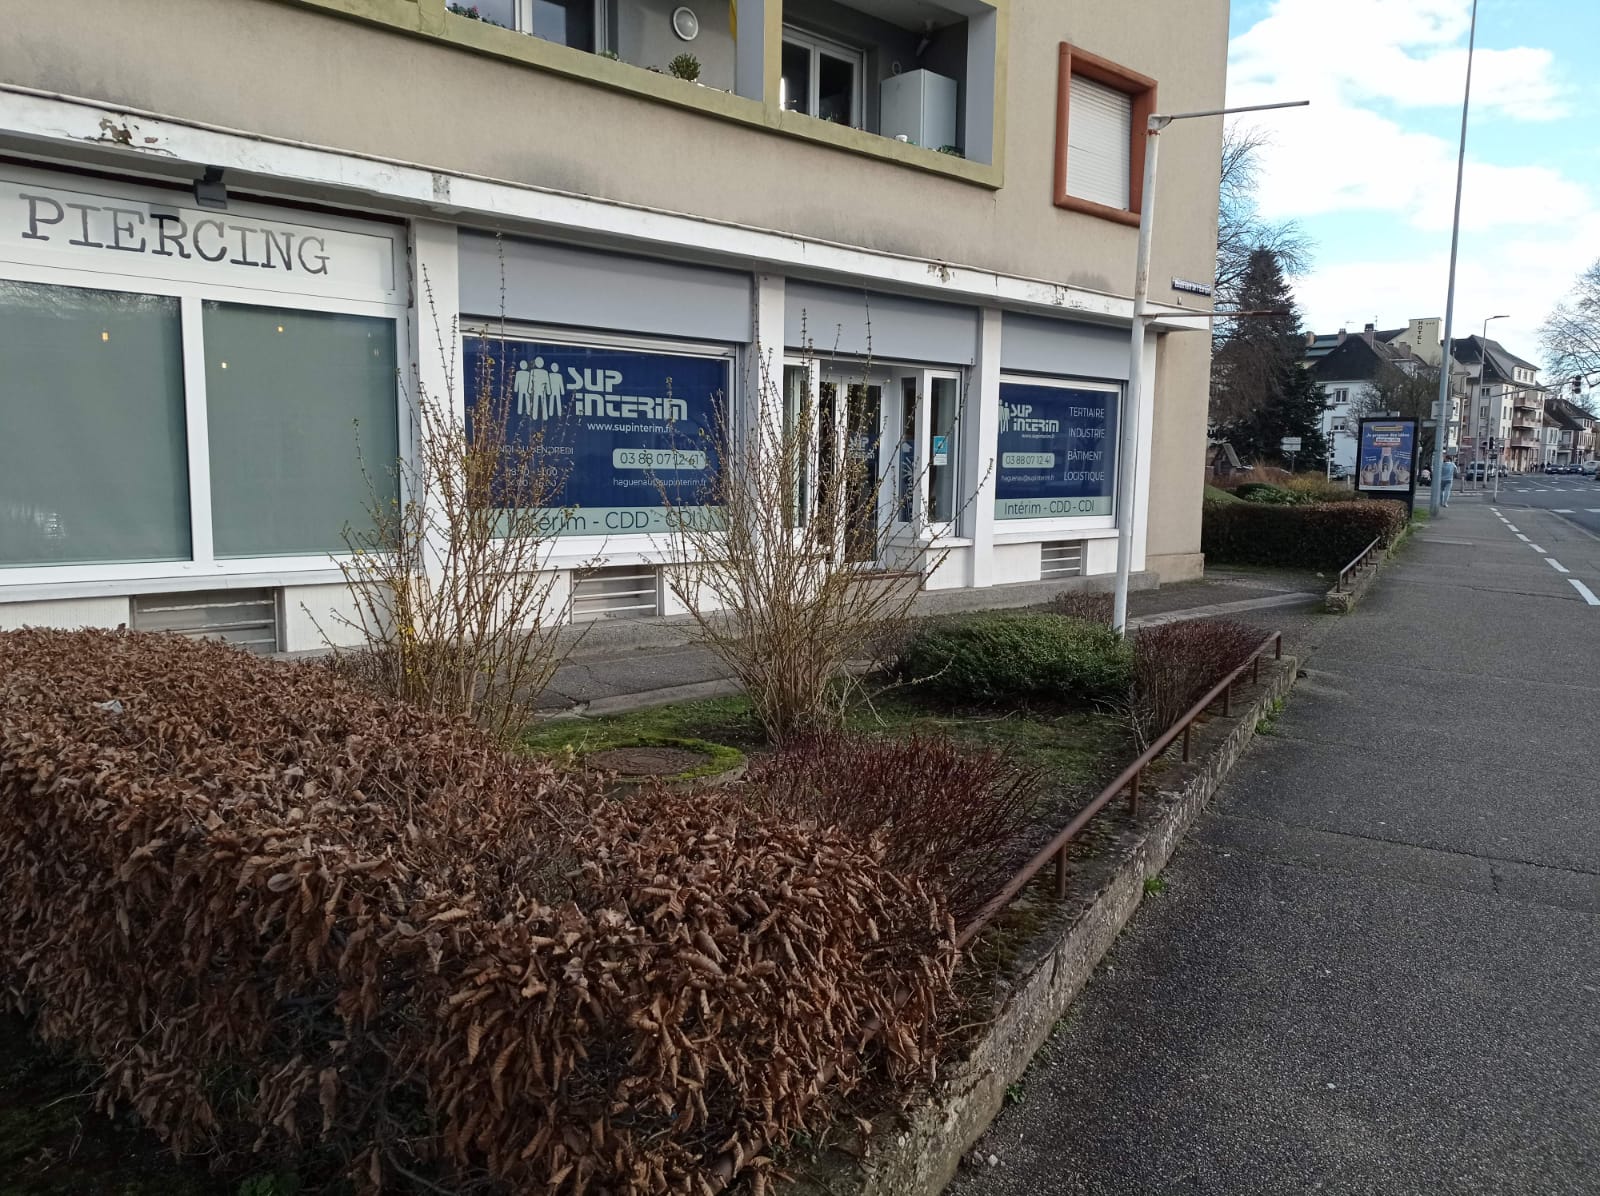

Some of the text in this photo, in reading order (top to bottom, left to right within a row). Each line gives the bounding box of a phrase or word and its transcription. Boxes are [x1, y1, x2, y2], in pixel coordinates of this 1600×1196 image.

[19, 193, 331, 275] PIERCING
[566, 367, 623, 393] SUP
[1010, 404, 1032, 417] SUP
[1069, 406, 1104, 418] TERTIAIRE
[1068, 427, 1105, 439] INDUSTRIE
[620, 452, 635, 464] 03
[638, 453, 653, 465] 88
[656, 453, 671, 465] 07
[673, 454, 685, 466] 12
[1005, 455, 1015, 465] 03
[1016, 455, 1025, 465] 88
[1026, 455, 1035, 465] 07
[1067, 450, 1102, 461] BÂTIMENT
[1064, 471, 1105, 482] LOGISTIQUE
[1004, 501, 1041, 515] Intérim
[1049, 500, 1072, 513] CDD
[1078, 499, 1095, 512] CDI
[605, 511, 649, 529] CDD
